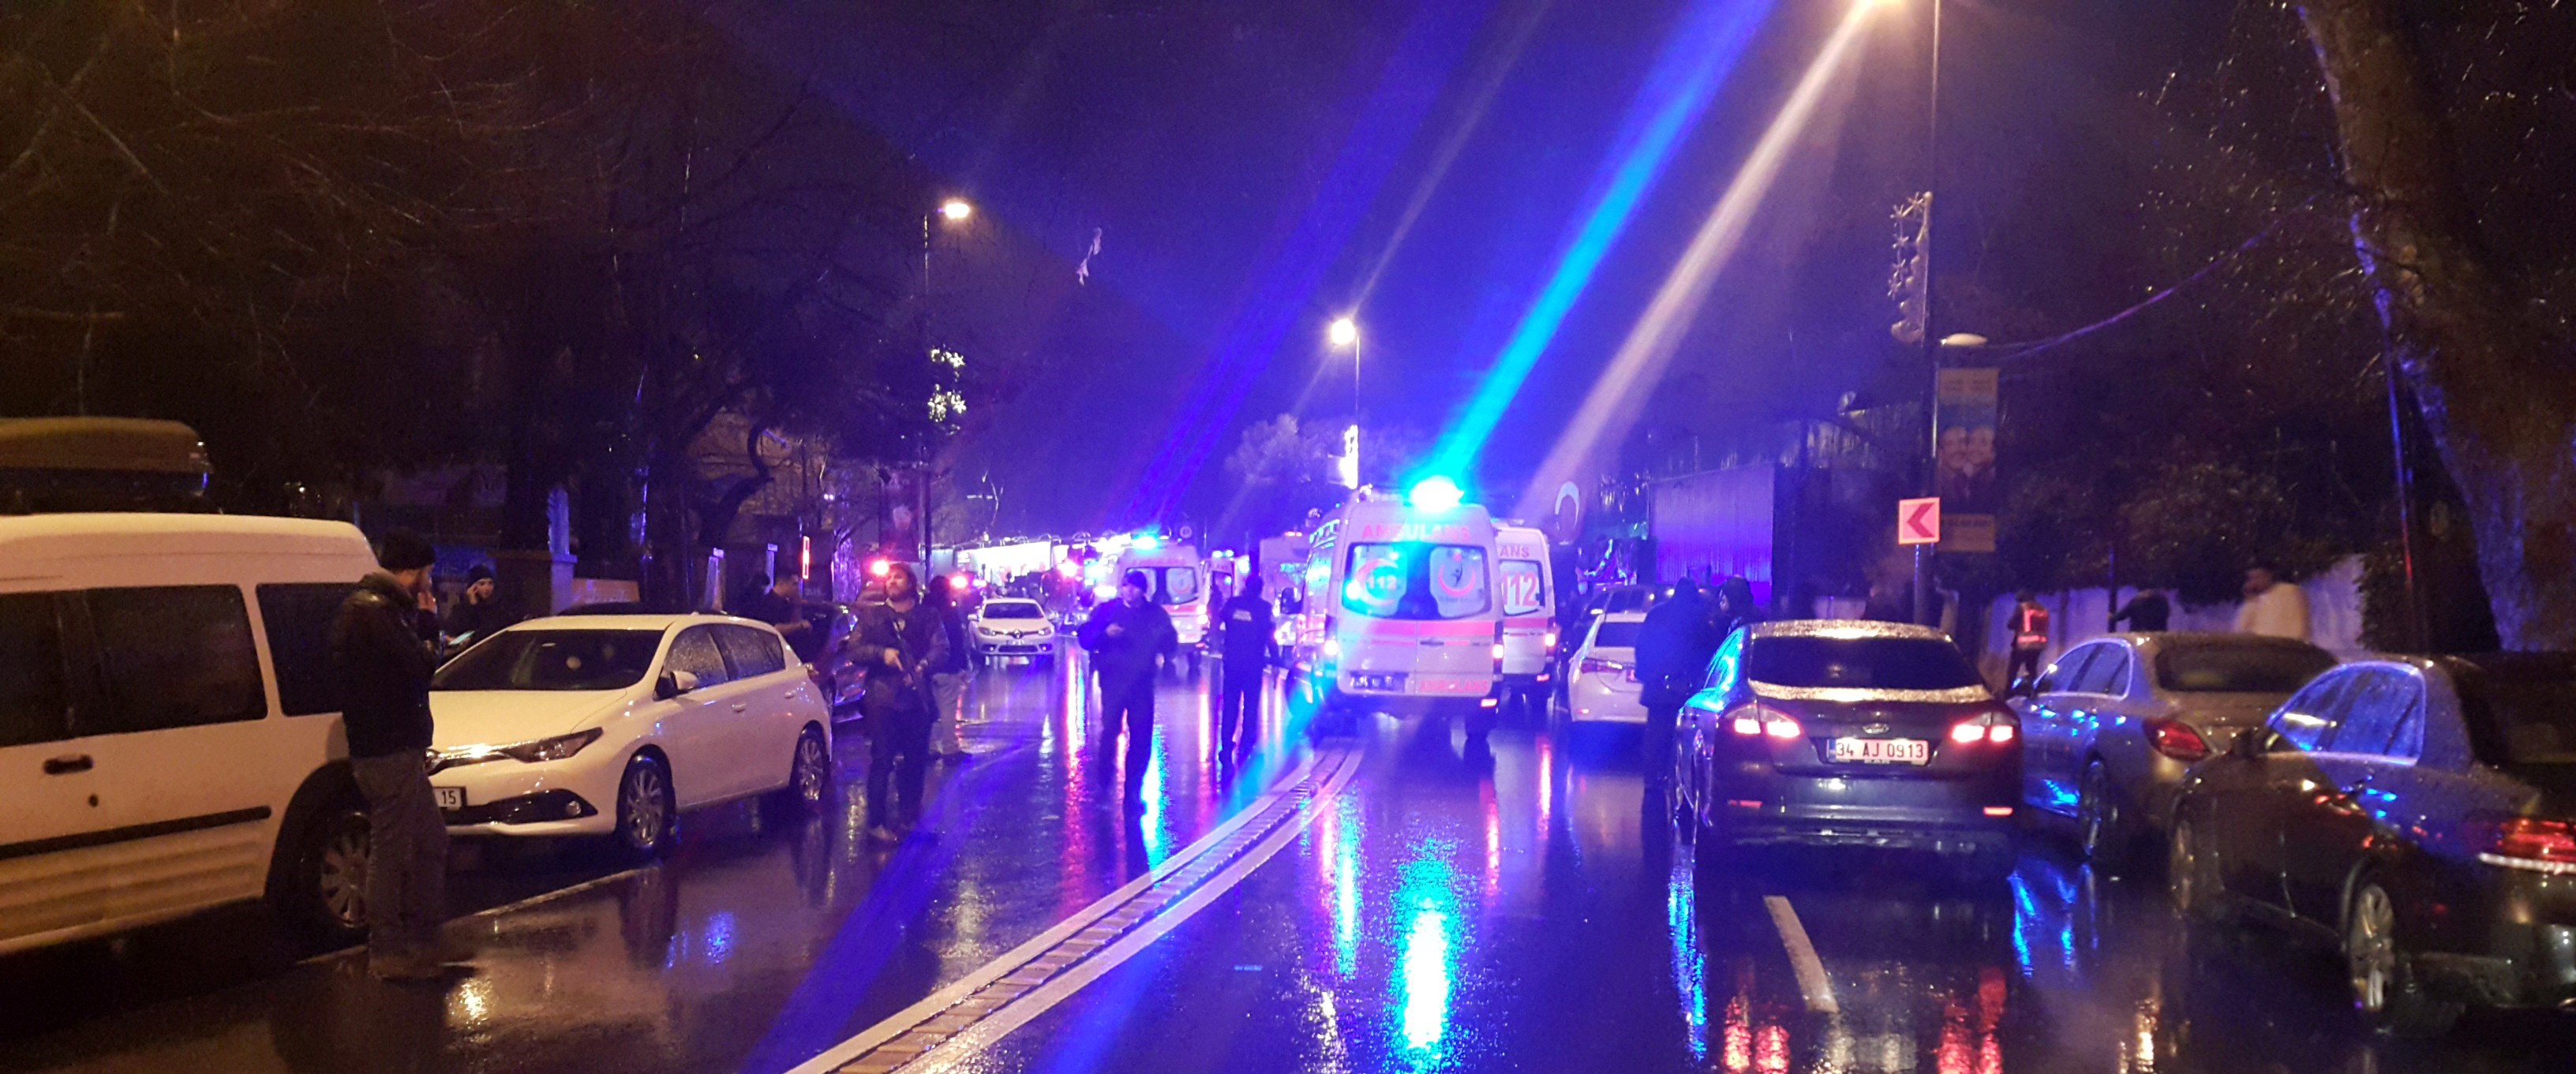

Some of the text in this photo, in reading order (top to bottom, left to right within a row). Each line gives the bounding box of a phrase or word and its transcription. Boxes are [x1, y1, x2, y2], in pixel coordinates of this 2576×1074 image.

[1361, 523, 1470, 542] AMBULANS
[1366, 574, 1397, 591] 112
[1503, 569, 1537, 607] 112
[1837, 743, 1923, 758] 34 AJ 0913
[442, 791, 456, 805] 15
